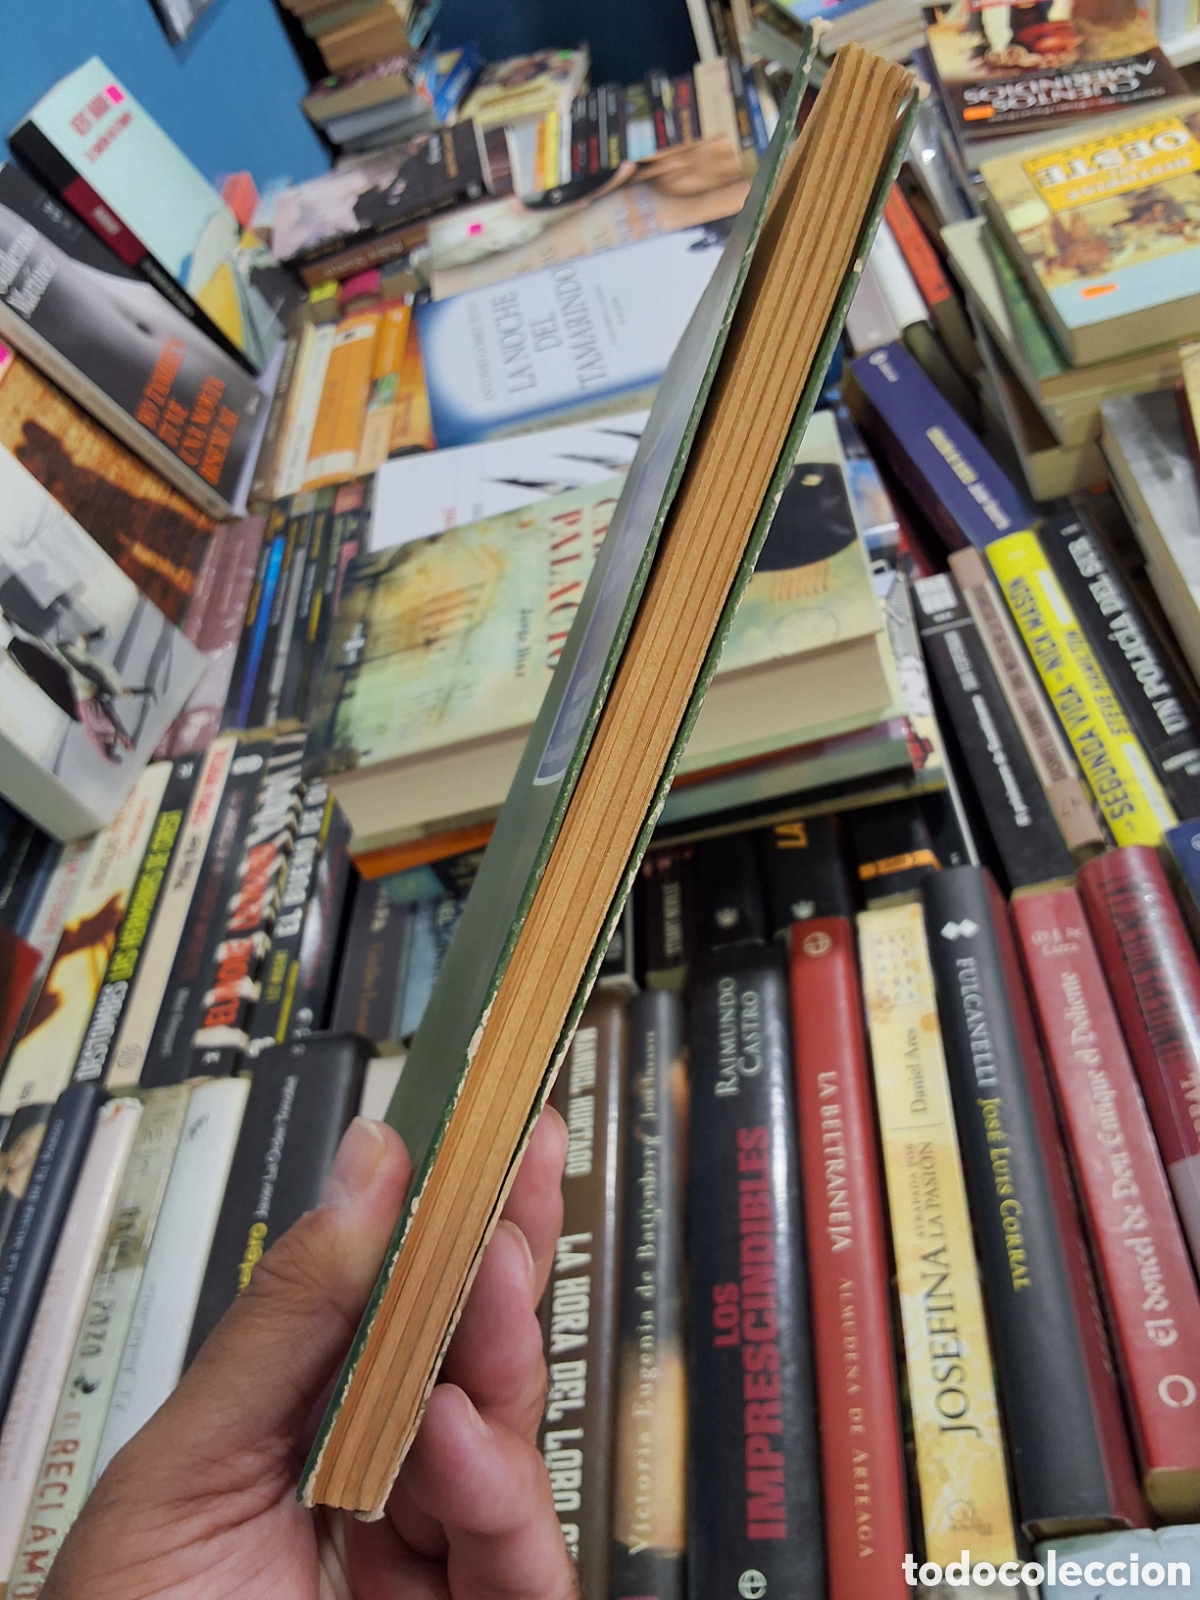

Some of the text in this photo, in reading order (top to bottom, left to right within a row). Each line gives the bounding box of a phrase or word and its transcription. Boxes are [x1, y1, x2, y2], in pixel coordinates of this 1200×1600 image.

[991, 77, 1140, 110] CUENTOS
[1039, 130, 1190, 188] OESTE
[491, 291, 537, 394] LA NOCHE
[533, 310, 560, 352] DEL
[551, 265, 608, 392] TAMARINDO
[1068, 536, 1104, 577] SUR
[1088, 572, 1125, 616] DEL
[519, 609, 533, 646] Jorge
[1008, 577, 1063, 672] NICK MASON
[1109, 612, 1164, 703] POLICÍA
[1056, 684, 1134, 819] SEGUNDA VIDA
[1152, 697, 1189, 736] UN
[275, 906, 302, 941] EL
[74, 980, 128, 1082] DESTOMBES
[715, 977, 740, 1097] RAIMUNDO
[737, 991, 763, 1077] CASTRO
[905, 1026, 928, 1114] Daniel Ares
[565, 1096, 596, 1177] HURTADO
[817, 1070, 853, 1253] LA BELTRANEJA
[956, 956, 1031, 1293] FULCANELLI JOSÉ LUIS CORRAL
[1111, 1148, 1140, 1200] Don
[555, 1232, 593, 1274] LA
[927, 1212, 946, 1238] LA
[1122, 1202, 1149, 1231] de
[633, 1269, 657, 1299] de
[1122, 1234, 1171, 1312] doncel
[549, 1276, 592, 1355] HORA
[713, 1281, 740, 1347] LOS
[737, 1125, 788, 1540] IMPRESCINDIBLES
[919, 1245, 982, 1438] JOSEFINA
[1145, 1317, 1179, 1347] El
[546, 1359, 588, 1423] DEL
[629, 1307, 663, 1418] Eugenia
[839, 1277, 876, 1559] ALMUDENA DE ARTEAGA
[625, 1429, 657, 1556] Victoria
